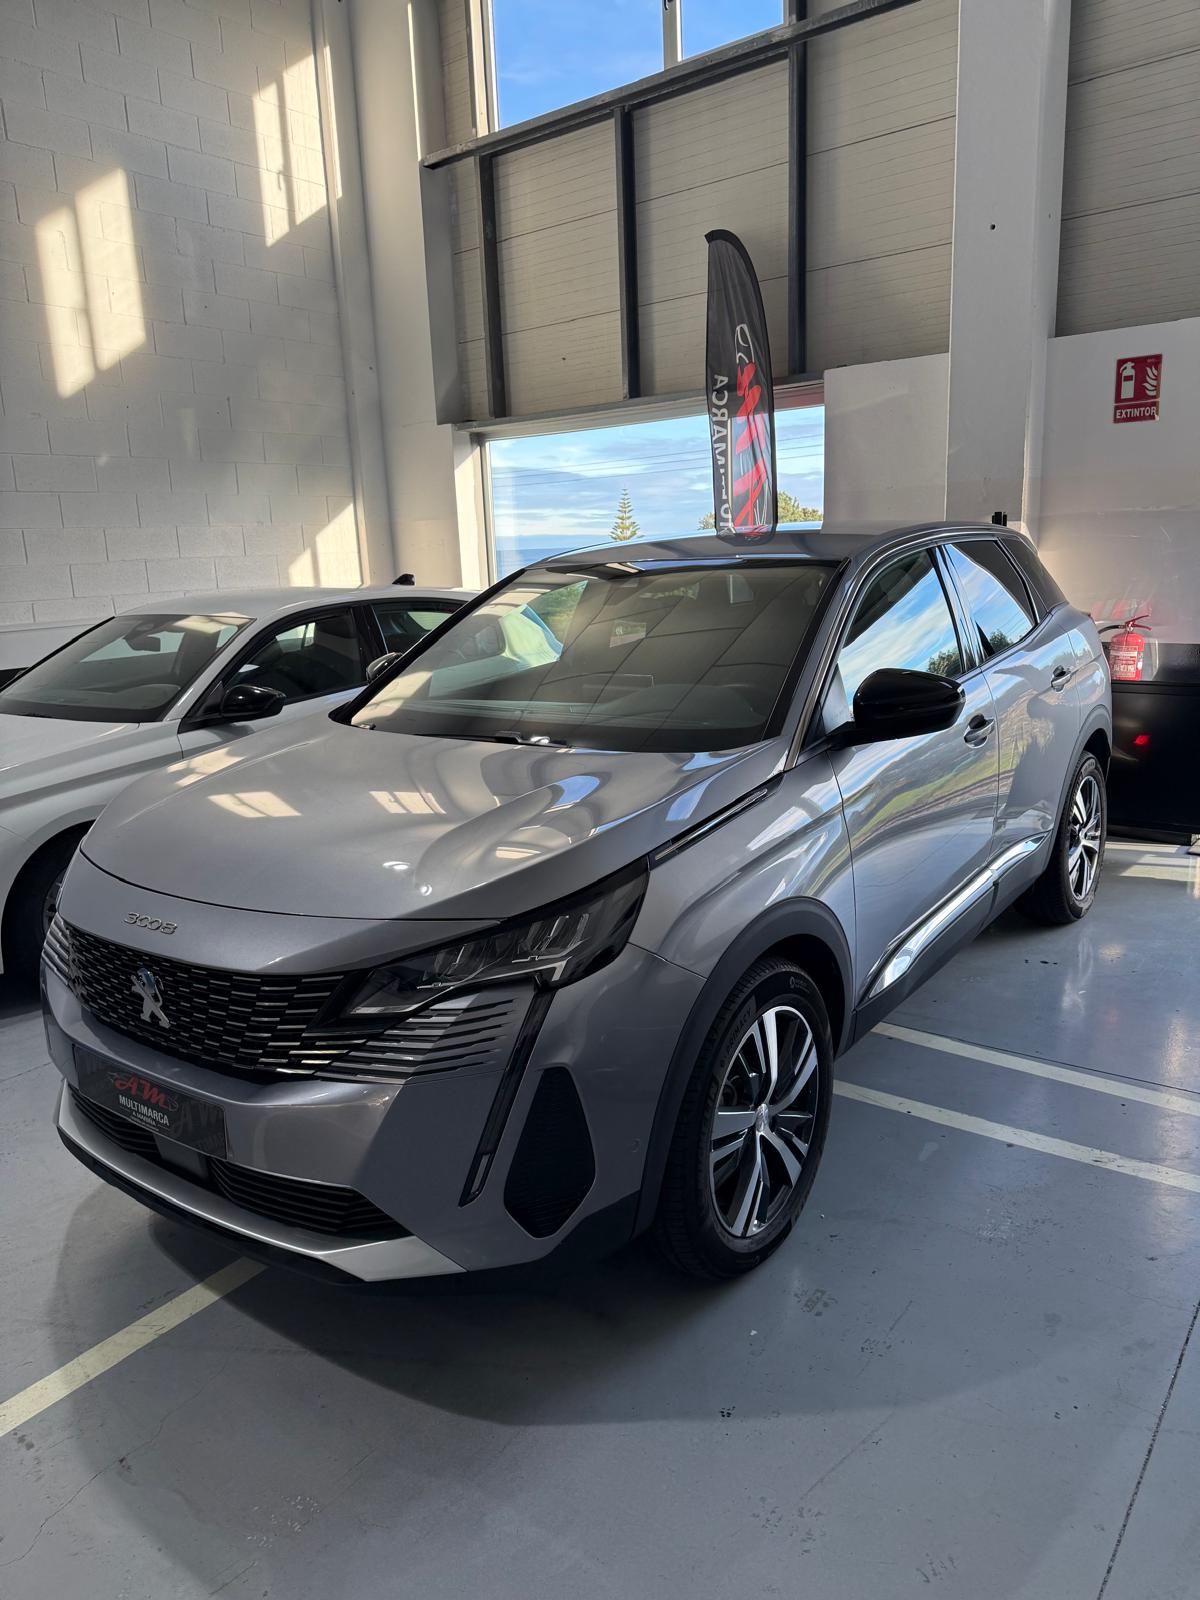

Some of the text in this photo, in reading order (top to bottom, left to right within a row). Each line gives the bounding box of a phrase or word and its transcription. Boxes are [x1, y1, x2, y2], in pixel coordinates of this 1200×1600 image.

[1116, 406, 1157, 419] EXTINTOR
[124, 912, 177, 935] 3008
[118, 1094, 170, 1126] MULTIMARCA
